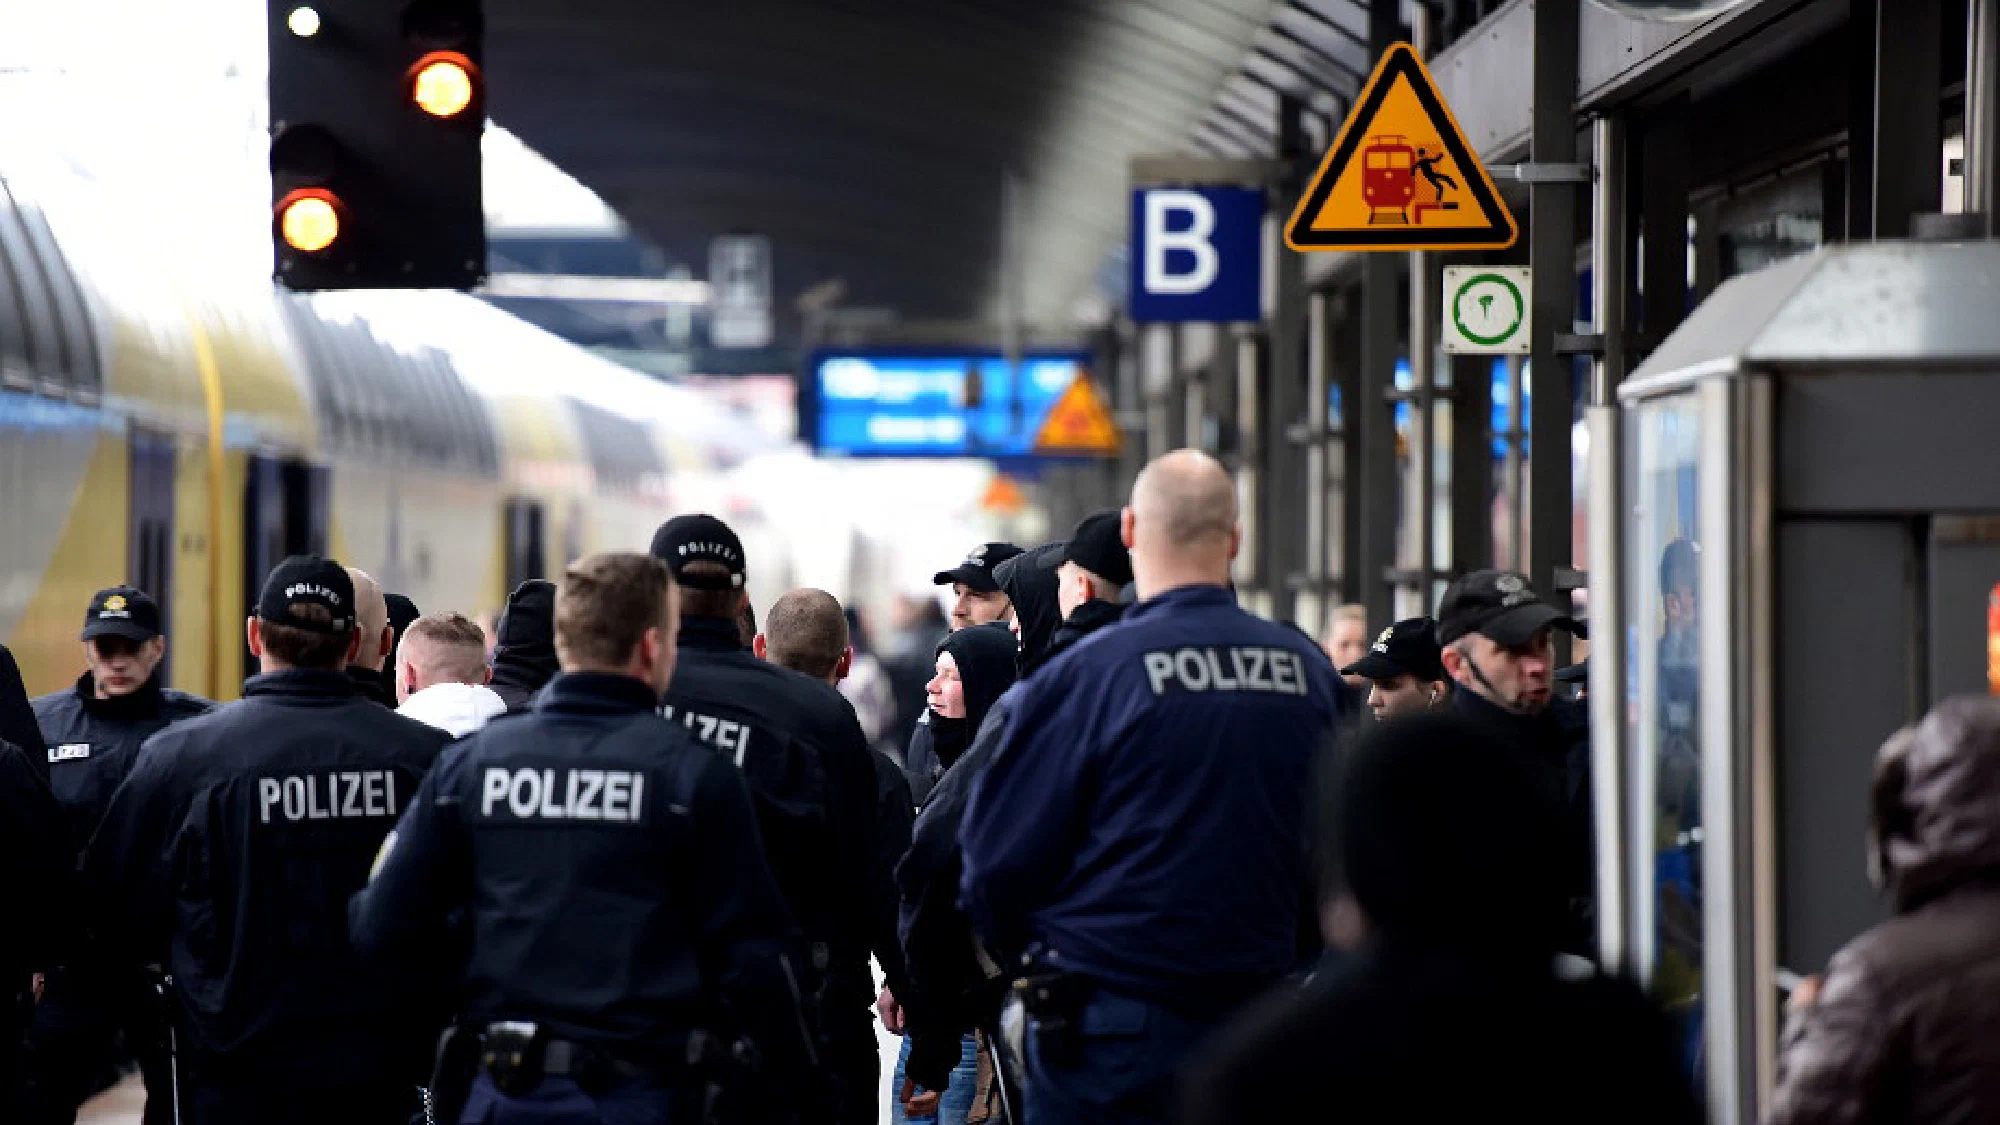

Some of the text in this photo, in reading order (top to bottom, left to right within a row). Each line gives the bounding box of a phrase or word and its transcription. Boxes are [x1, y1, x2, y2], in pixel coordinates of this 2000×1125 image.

[1144, 189, 1220, 294] B
[678, 541, 737, 561] POLIZEI
[1144, 647, 1308, 695] POLIZEI
[258, 770, 397, 824] POLIZEI
[481, 767, 644, 823] POLIZEI
